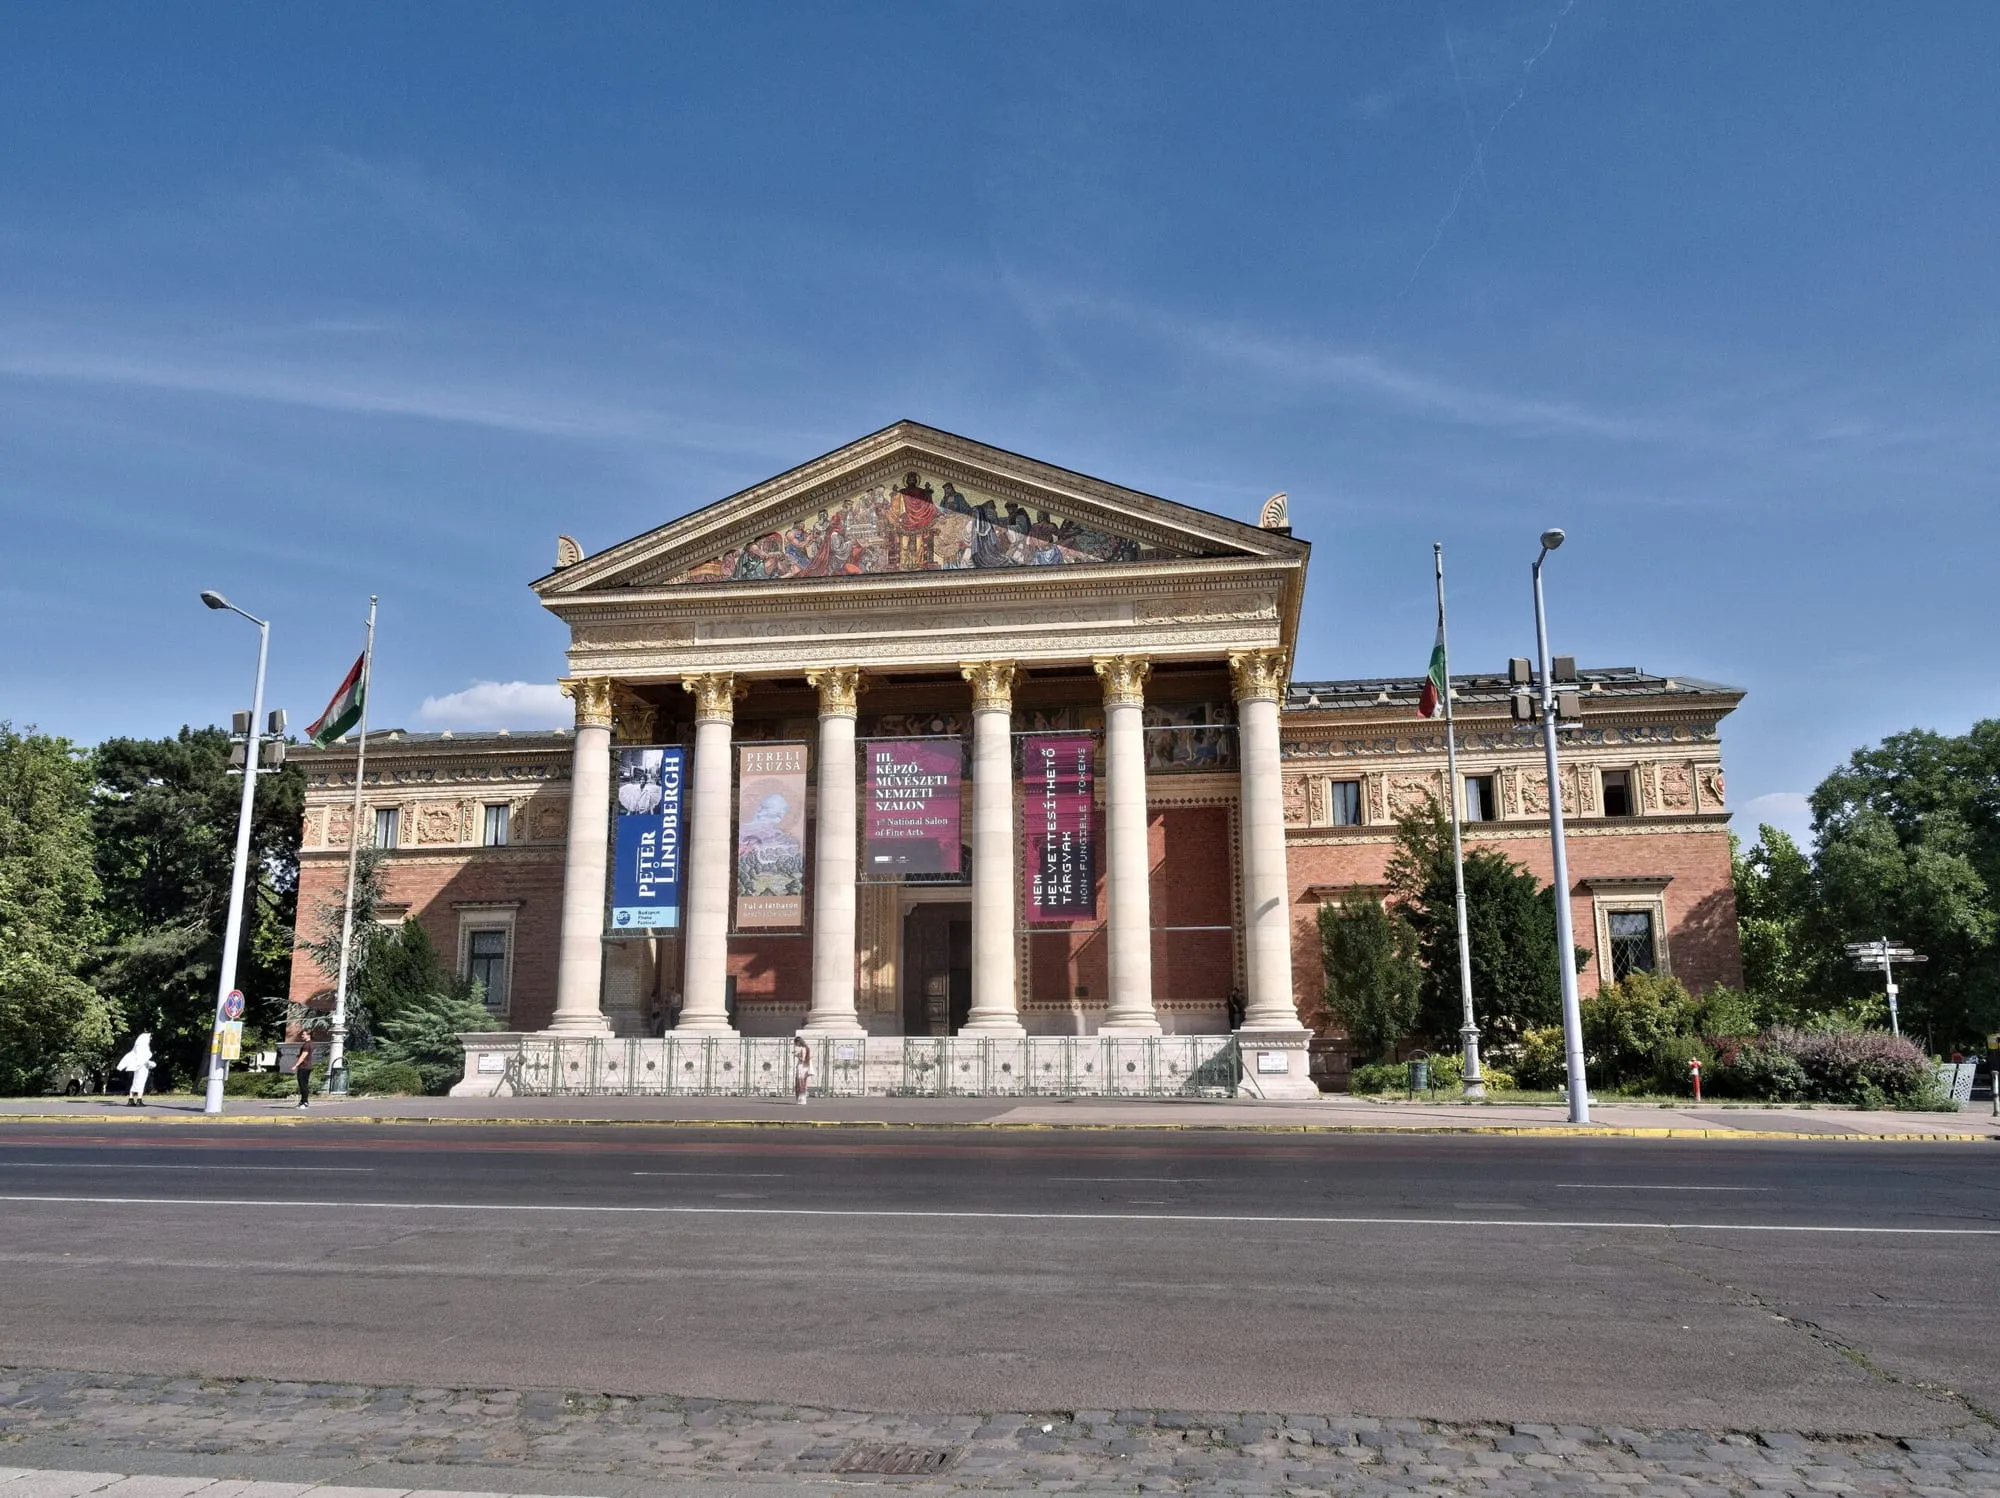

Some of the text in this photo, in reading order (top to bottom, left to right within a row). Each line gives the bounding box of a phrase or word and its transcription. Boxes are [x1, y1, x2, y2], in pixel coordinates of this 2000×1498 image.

[747, 751, 800, 762] PERELI
[876, 752, 894, 763] III.
[746, 761, 801, 771] ZSUZSA
[876, 773, 948, 787] MŰVÉSZETI
[876, 788, 933, 799] NEMZETI
[876, 801, 925, 812] SZALON
[654, 756, 680, 883] LINDBERGH
[888, 816, 922, 826] National
[925, 816, 948, 825] Salon
[1078, 747, 1089, 904] NON-FUNGIBLE TOKENS
[875, 828, 924, 837] of Fine Arts
[1041, 748, 1057, 905] HELYETTESÍTHETŐ
[638, 830, 656, 897] PETER
[1058, 831, 1072, 905] TÁRGYAK
[1033, 874, 1043, 906] NEM
